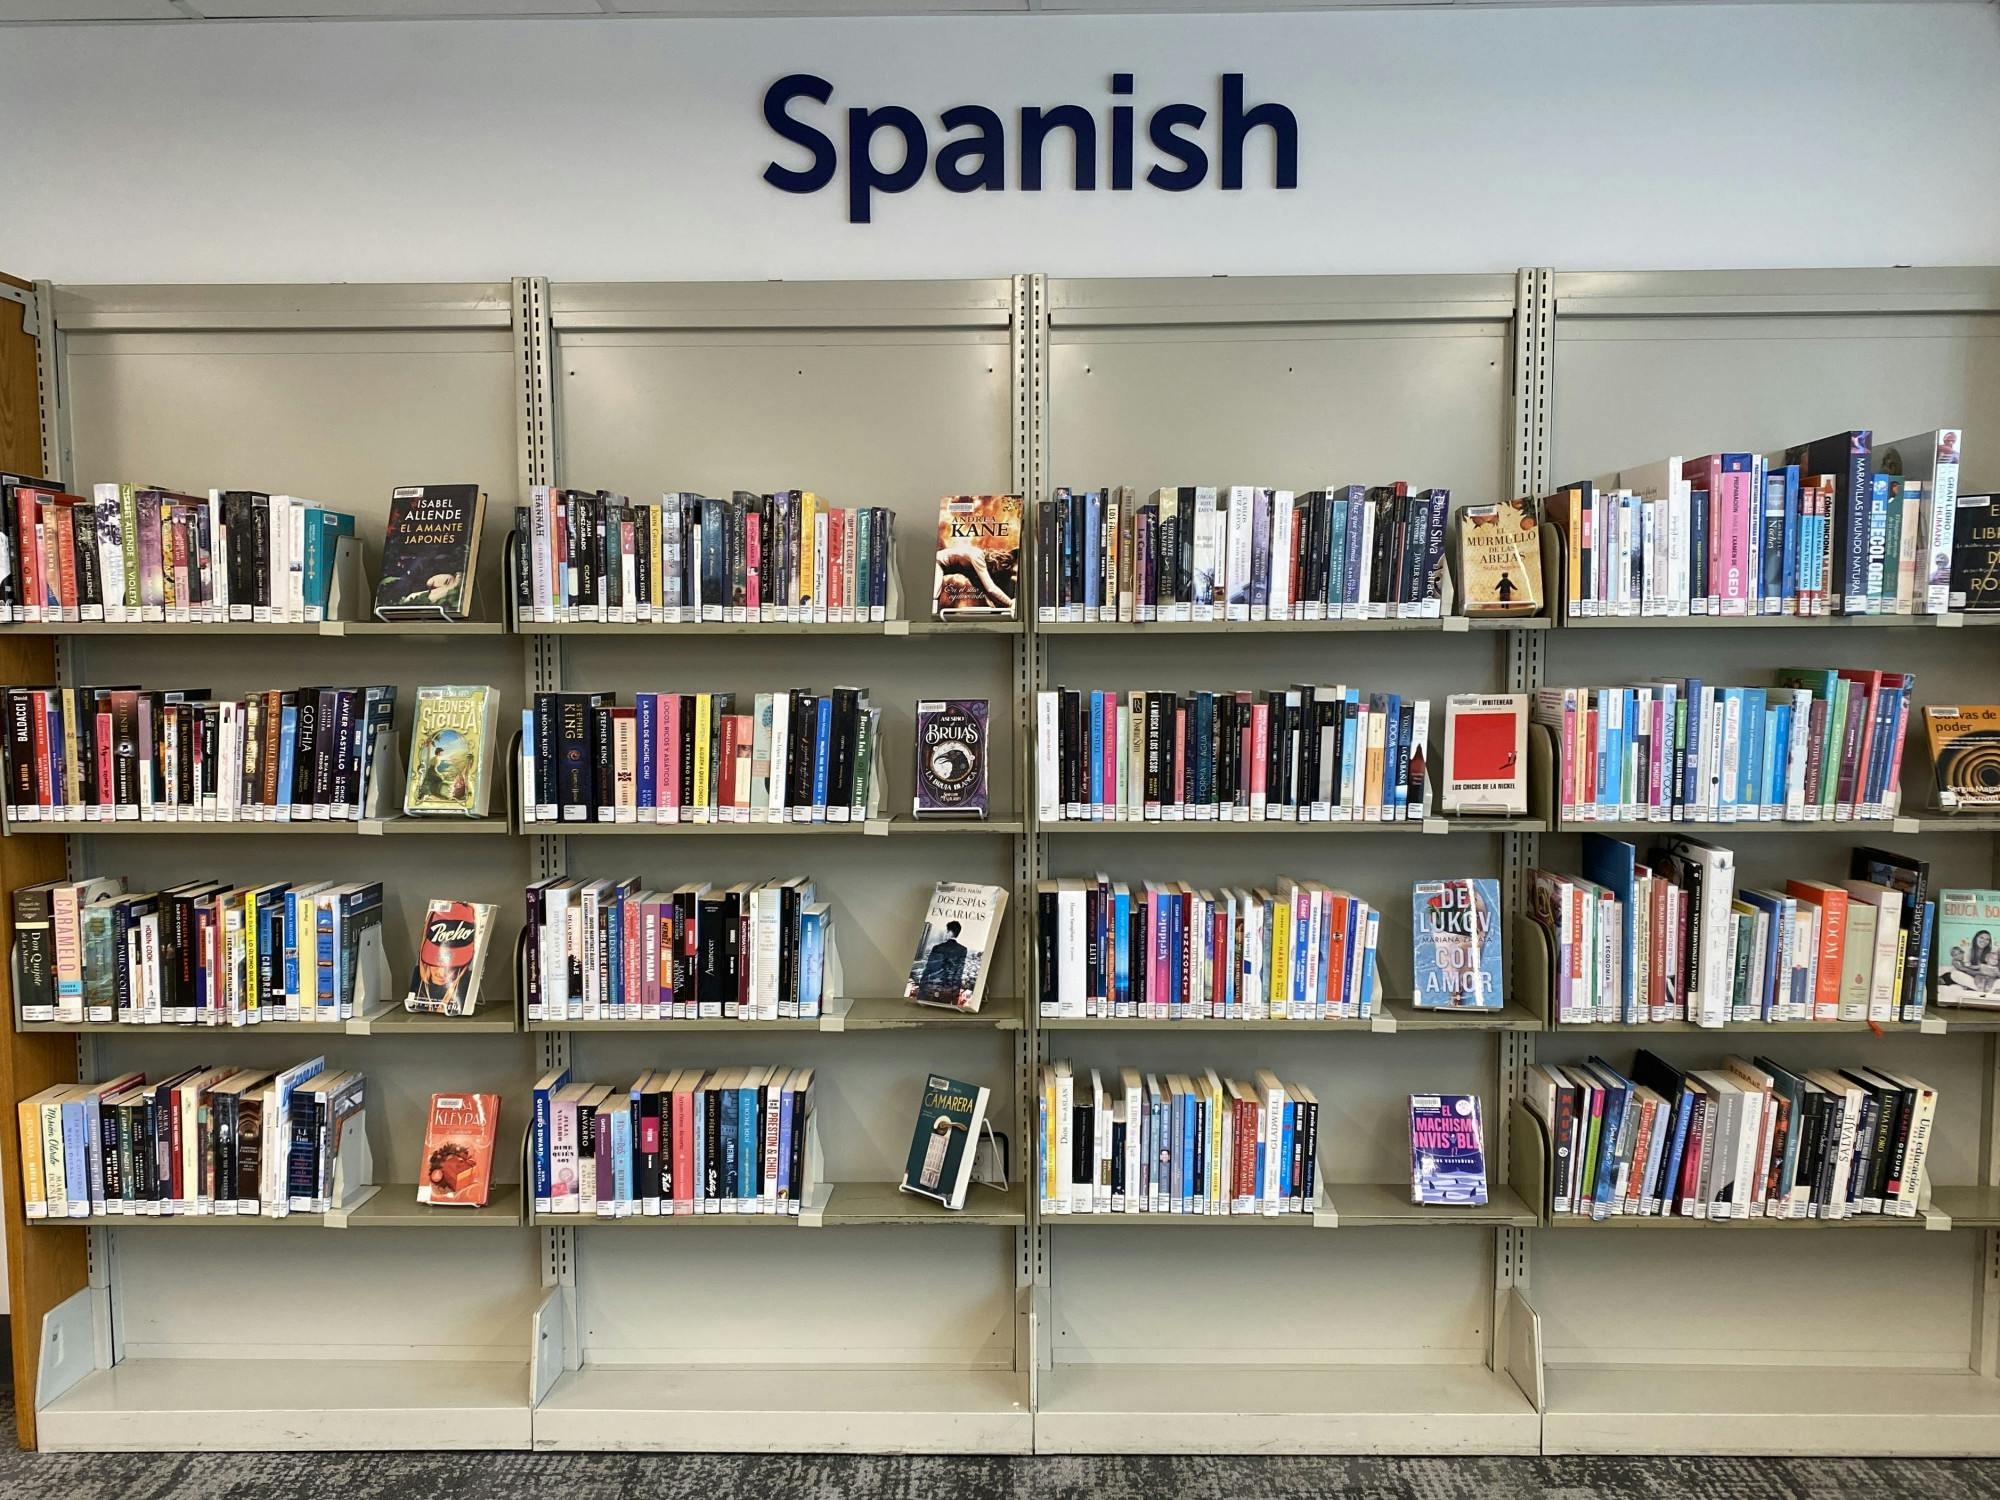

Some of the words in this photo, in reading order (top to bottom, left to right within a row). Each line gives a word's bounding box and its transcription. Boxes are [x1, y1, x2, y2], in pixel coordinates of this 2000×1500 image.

[762, 72, 1298, 224] Spanish
[1855, 458, 1865, 510] MARAVILLAS
[1946, 477, 1955, 502] GRAN
[405, 510, 461, 520] ALLENDE
[417, 499, 452, 508] ISABEL
[535, 494, 544, 536] HANNAH
[1432, 495, 1445, 527] Daniel
[125, 522, 134, 556] ALLENDE
[400, 524, 411, 532] EL
[416, 523, 463, 532] AMANTE
[404, 532, 454, 544] JAPONÉS
[951, 523, 1008, 537] KANE
[1137, 528, 1144, 539] La
[1768, 520, 1777, 549] Noches
[1853, 517, 1863, 554] MUNDO
[1934, 506, 1943, 548] HUMANO
[1137, 541, 1145, 561] Casa
[1429, 529, 1442, 554] Silva
[1728, 568, 1738, 596] GED
[1851, 556, 1861, 595] NATURAL
[128, 573, 137, 604] VIOLETA
[1411, 578, 1420, 601] SIERRA
[341, 698, 349, 727] JAVIER
[643, 701, 649, 709] LA
[1151, 701, 1158, 710] LA
[17, 703, 27, 742] BALDACCI
[302, 705, 314, 752] GOTHIA
[565, 704, 575, 739] KING
[859, 716, 868, 739] Berta
[1150, 712, 1159, 730] MÚSICA
[1936, 722, 1972, 732] poder
[686, 733, 691, 742] UN
[926, 723, 978, 744] BRUJAS
[338, 730, 347, 770] CASTILLO
[858, 741, 867, 756] Isla
[685, 777, 690, 785] EN
[1399, 754, 1407, 784] CABAÑA
[1663, 774, 1671, 801] YOGA
[1300, 899, 1308, 918] César
[1442, 888, 1469, 908] DE
[430, 922, 474, 942] Pocho
[646, 915, 654, 928] UNA
[1912, 904, 1923, 945] LUGARES
[30, 932, 42, 951] Don
[55, 899, 75, 972] CARAMELO
[248, 939, 254, 947] LO
[1824, 910, 1838, 959] BOOM
[1921, 948, 1928, 956] LA
[31, 953, 43, 986] Quijote
[261, 956, 271, 998] CANTORAS
[646, 955, 655, 982] PARADA
[1426, 972, 1492, 992] AMOR
[924, 1093, 973, 1113] CAMARERA
[1442, 1105, 1452, 1116] EL
[767, 1112, 778, 1146] PRESTON
[1250, 1129, 1255, 1137] EL
[1271, 1100, 1279, 1149] GLADWELL
[1881, 1124, 1889, 1135] DE
[1917, 1118, 1931, 1139] Una
[1839, 1114, 1855, 1162] SALVAJE
[1877, 1136, 1886, 1153] ORO
[48, 1139, 59, 1166] Olvido
[726, 1144, 734, 1163] REINA
[1702, 1132, 1714, 1173] MORENO
[1893, 1143, 1905, 1178] OSCURO
[766, 1156, 776, 1179] CHILD
[1908, 1142, 1924, 1194] educación
